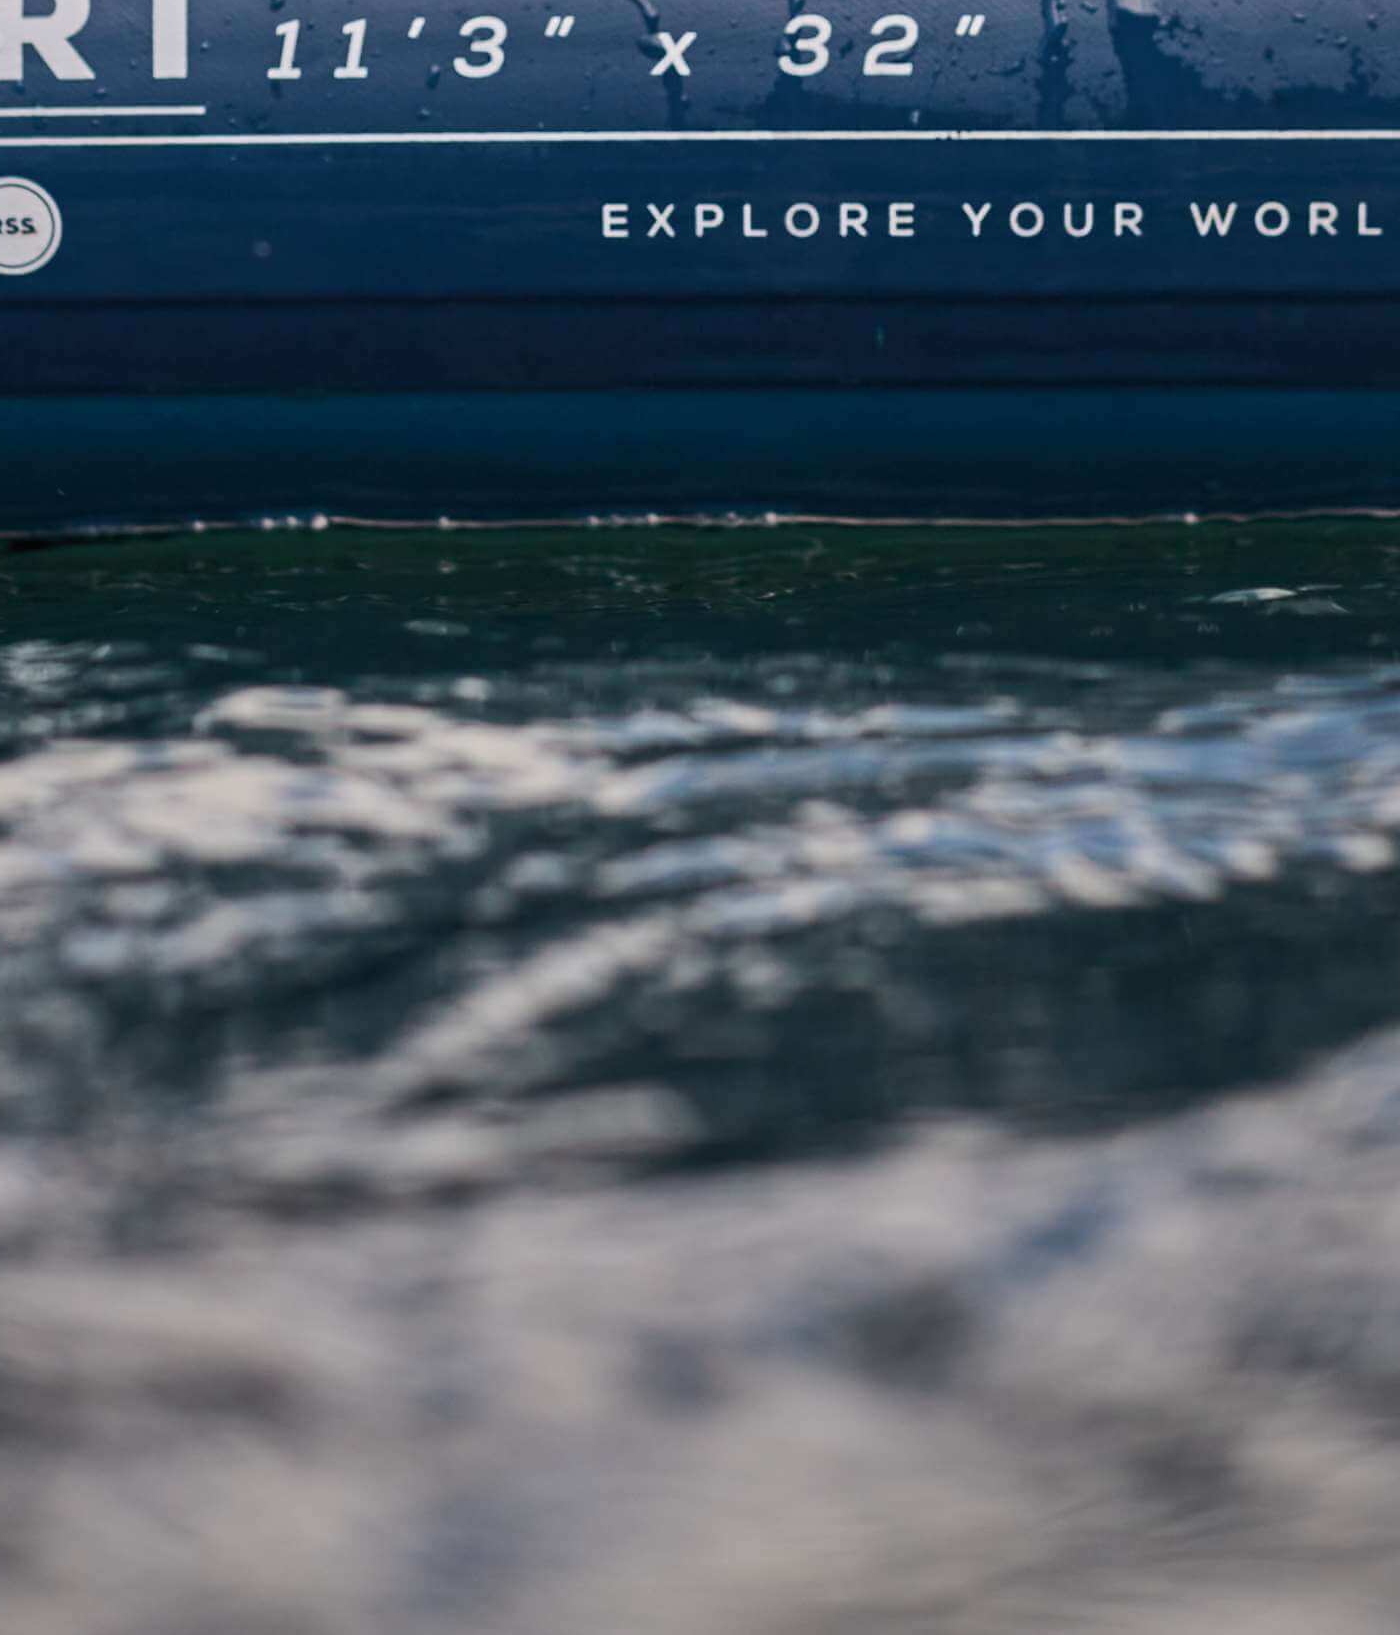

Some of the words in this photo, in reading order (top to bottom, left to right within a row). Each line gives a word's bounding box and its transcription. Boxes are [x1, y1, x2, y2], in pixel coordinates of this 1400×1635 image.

[778, 13, 986, 77] 32"
[601, 202, 916, 239] EXPLORE
[961, 201, 1144, 238] YOUR
